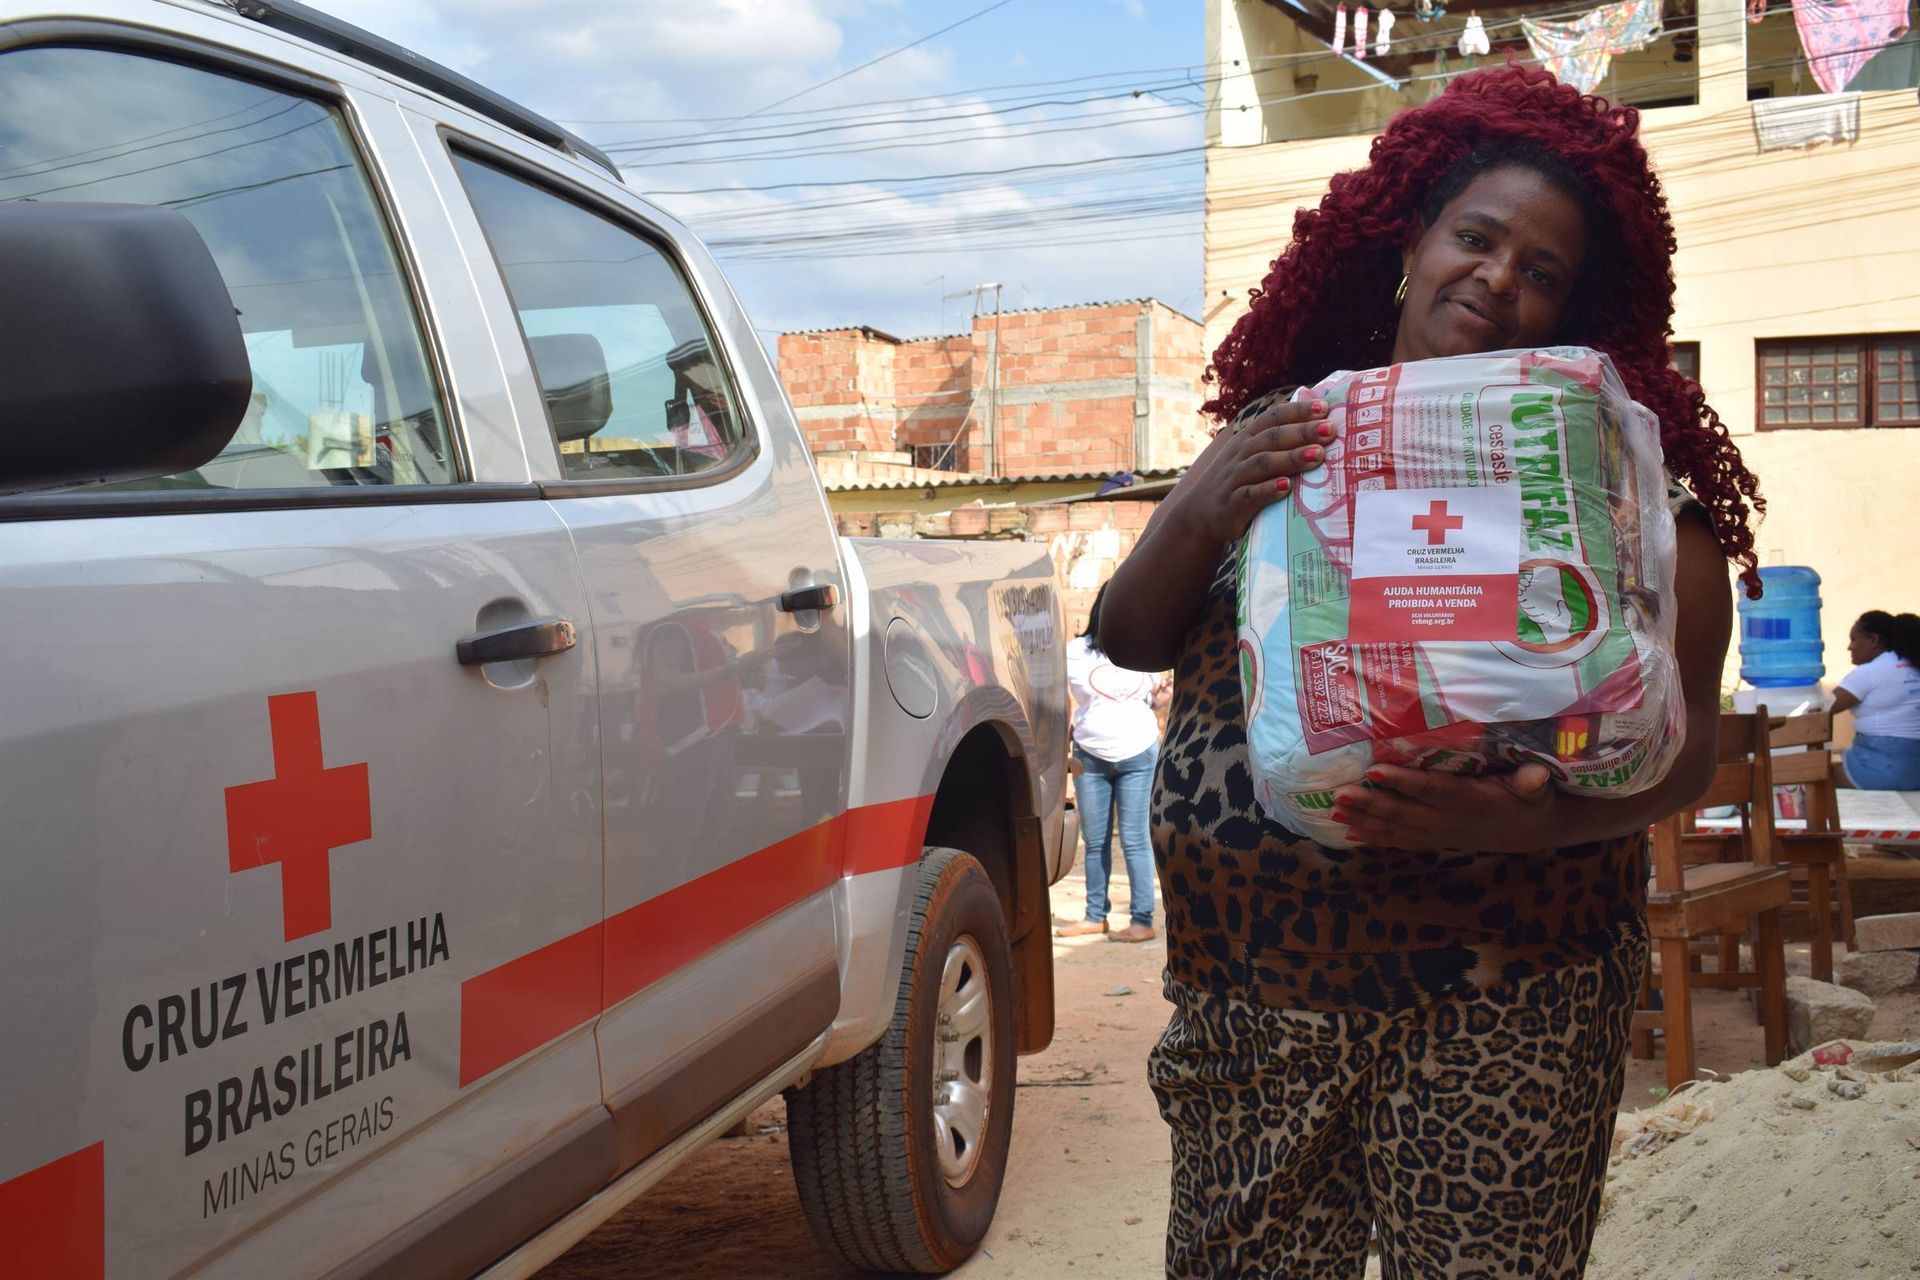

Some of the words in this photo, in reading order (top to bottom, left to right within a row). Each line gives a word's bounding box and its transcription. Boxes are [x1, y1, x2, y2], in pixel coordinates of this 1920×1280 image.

[1460, 392, 1474, 430] QLIDADE
[1488, 424, 1509, 469] cestas
[1407, 548, 1426, 556] CRUZ
[1427, 547, 1465, 555] VERMELHA
[1414, 556, 1456, 564] BRASILEIRA
[1383, 586, 1413, 596] AJUDA
[1416, 584, 1483, 596] HUMANITÁRIA
[1388, 599, 1435, 608] PROIBIDA
[1436, 599, 1444, 608] A
[1444, 598, 1477, 608] VENDA
[1411, 618, 1455, 626] cvbmg.org.br
[1310, 649, 1322, 669] (31)
[1324, 643, 1349, 676] SAC
[1313, 672, 1325, 698] 3392
[1317, 700, 1331, 725] 2227
[1570, 757, 1620, 773] alimentos
[122, 972, 248, 1072] CRUZ
[256, 911, 450, 1025] VERMELHA
[184, 1010, 412, 1157] BRASILEIRA
[202, 1140, 296, 1218] MINAS
[304, 1095, 394, 1167] GERAIS
